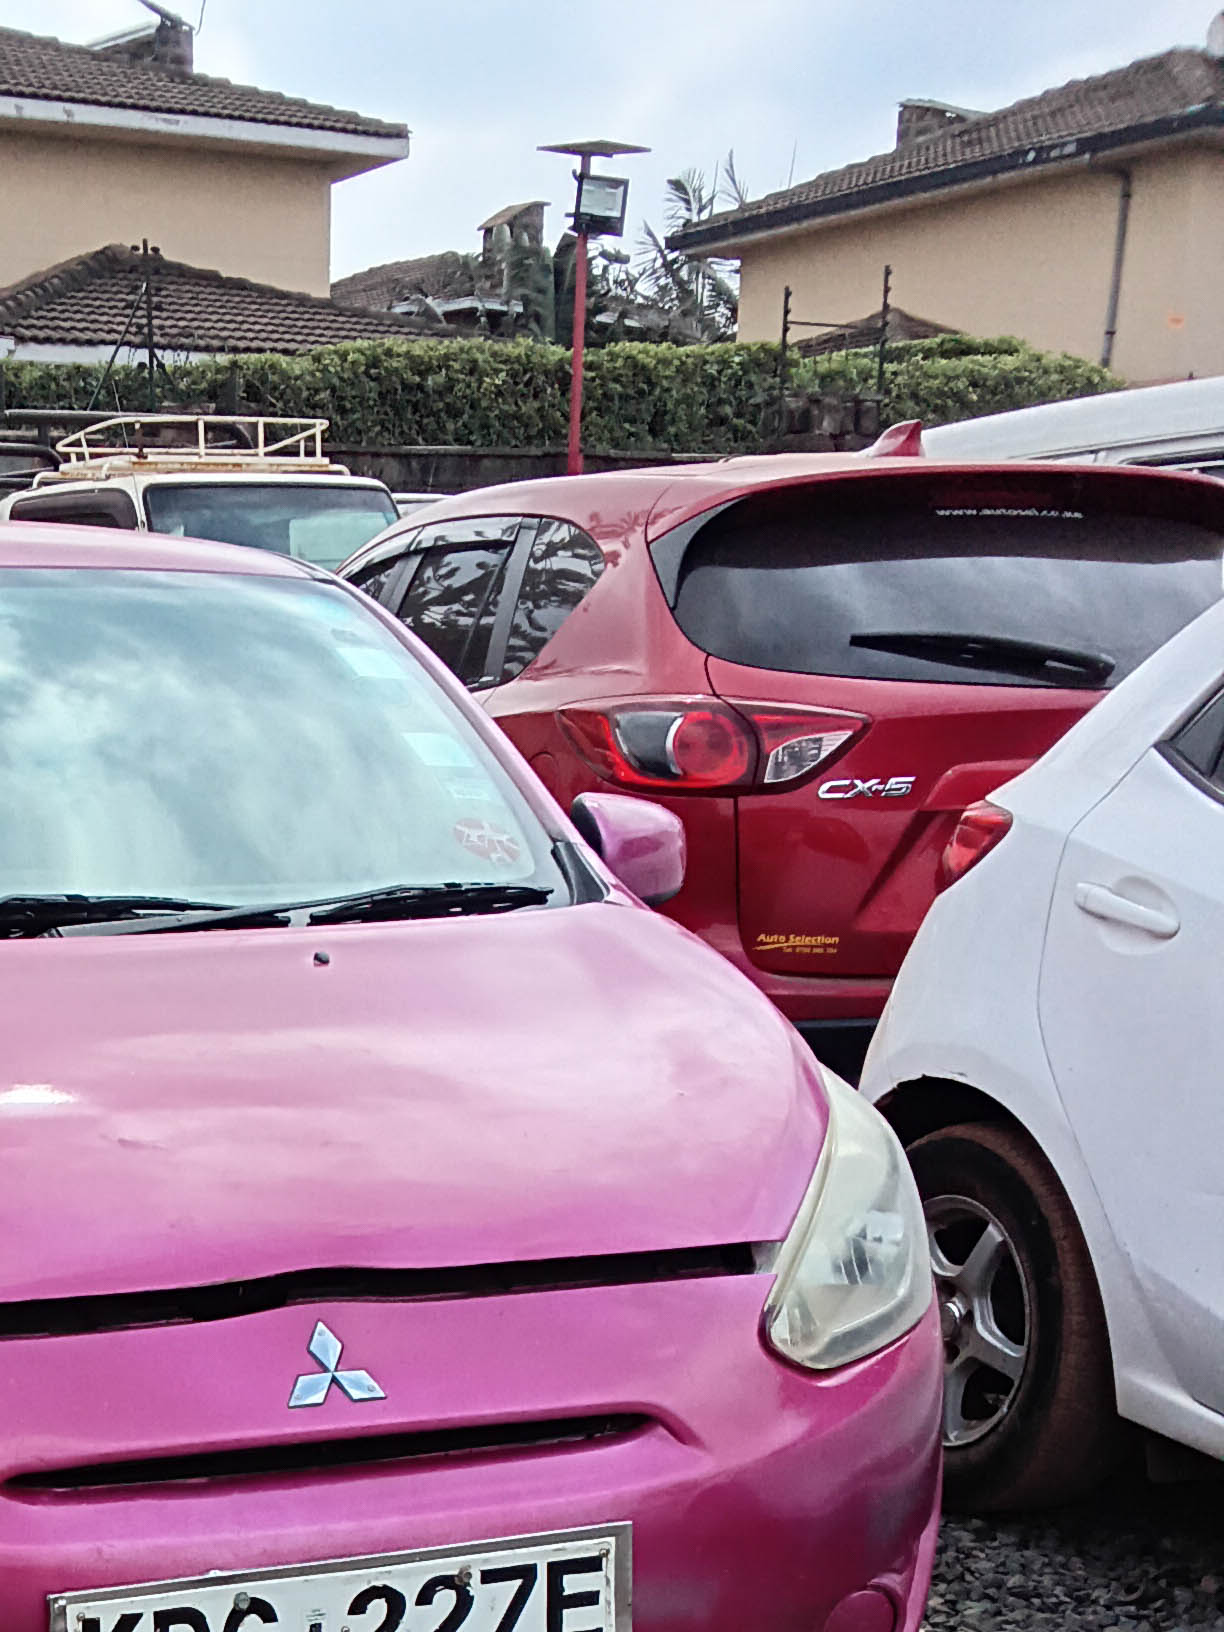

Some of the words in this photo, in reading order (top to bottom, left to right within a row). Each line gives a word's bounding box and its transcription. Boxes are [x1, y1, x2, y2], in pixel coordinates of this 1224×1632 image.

[818, 776, 917, 800] CX-5
[756, 933, 786, 943] Auto
[788, 934, 840, 945] Selection
